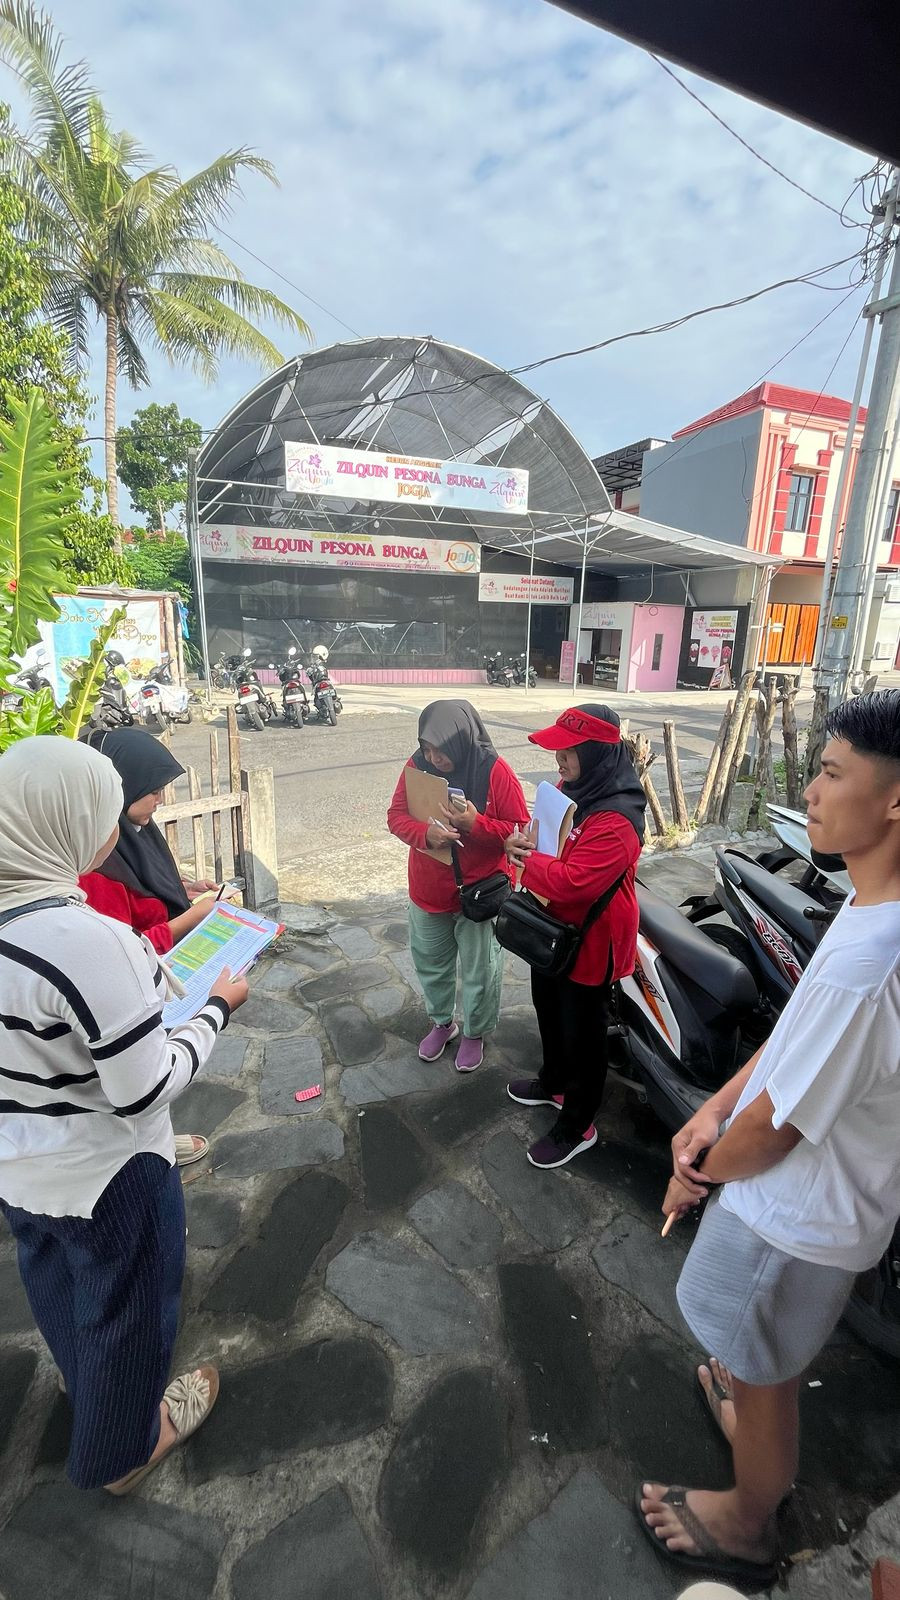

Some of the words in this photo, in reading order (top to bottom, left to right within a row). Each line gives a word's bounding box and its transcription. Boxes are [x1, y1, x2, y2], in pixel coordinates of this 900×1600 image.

[336, 460, 389, 479] ZILQUIN
[394, 467, 442, 485] PESONA
[446, 473, 487, 490] BUNGA
[397, 482, 432, 501] JOGJA
[252, 535, 314, 555] ZILQUIN
[320, 540, 376, 557] PESONA
[382, 544, 429, 560] BUNGA
